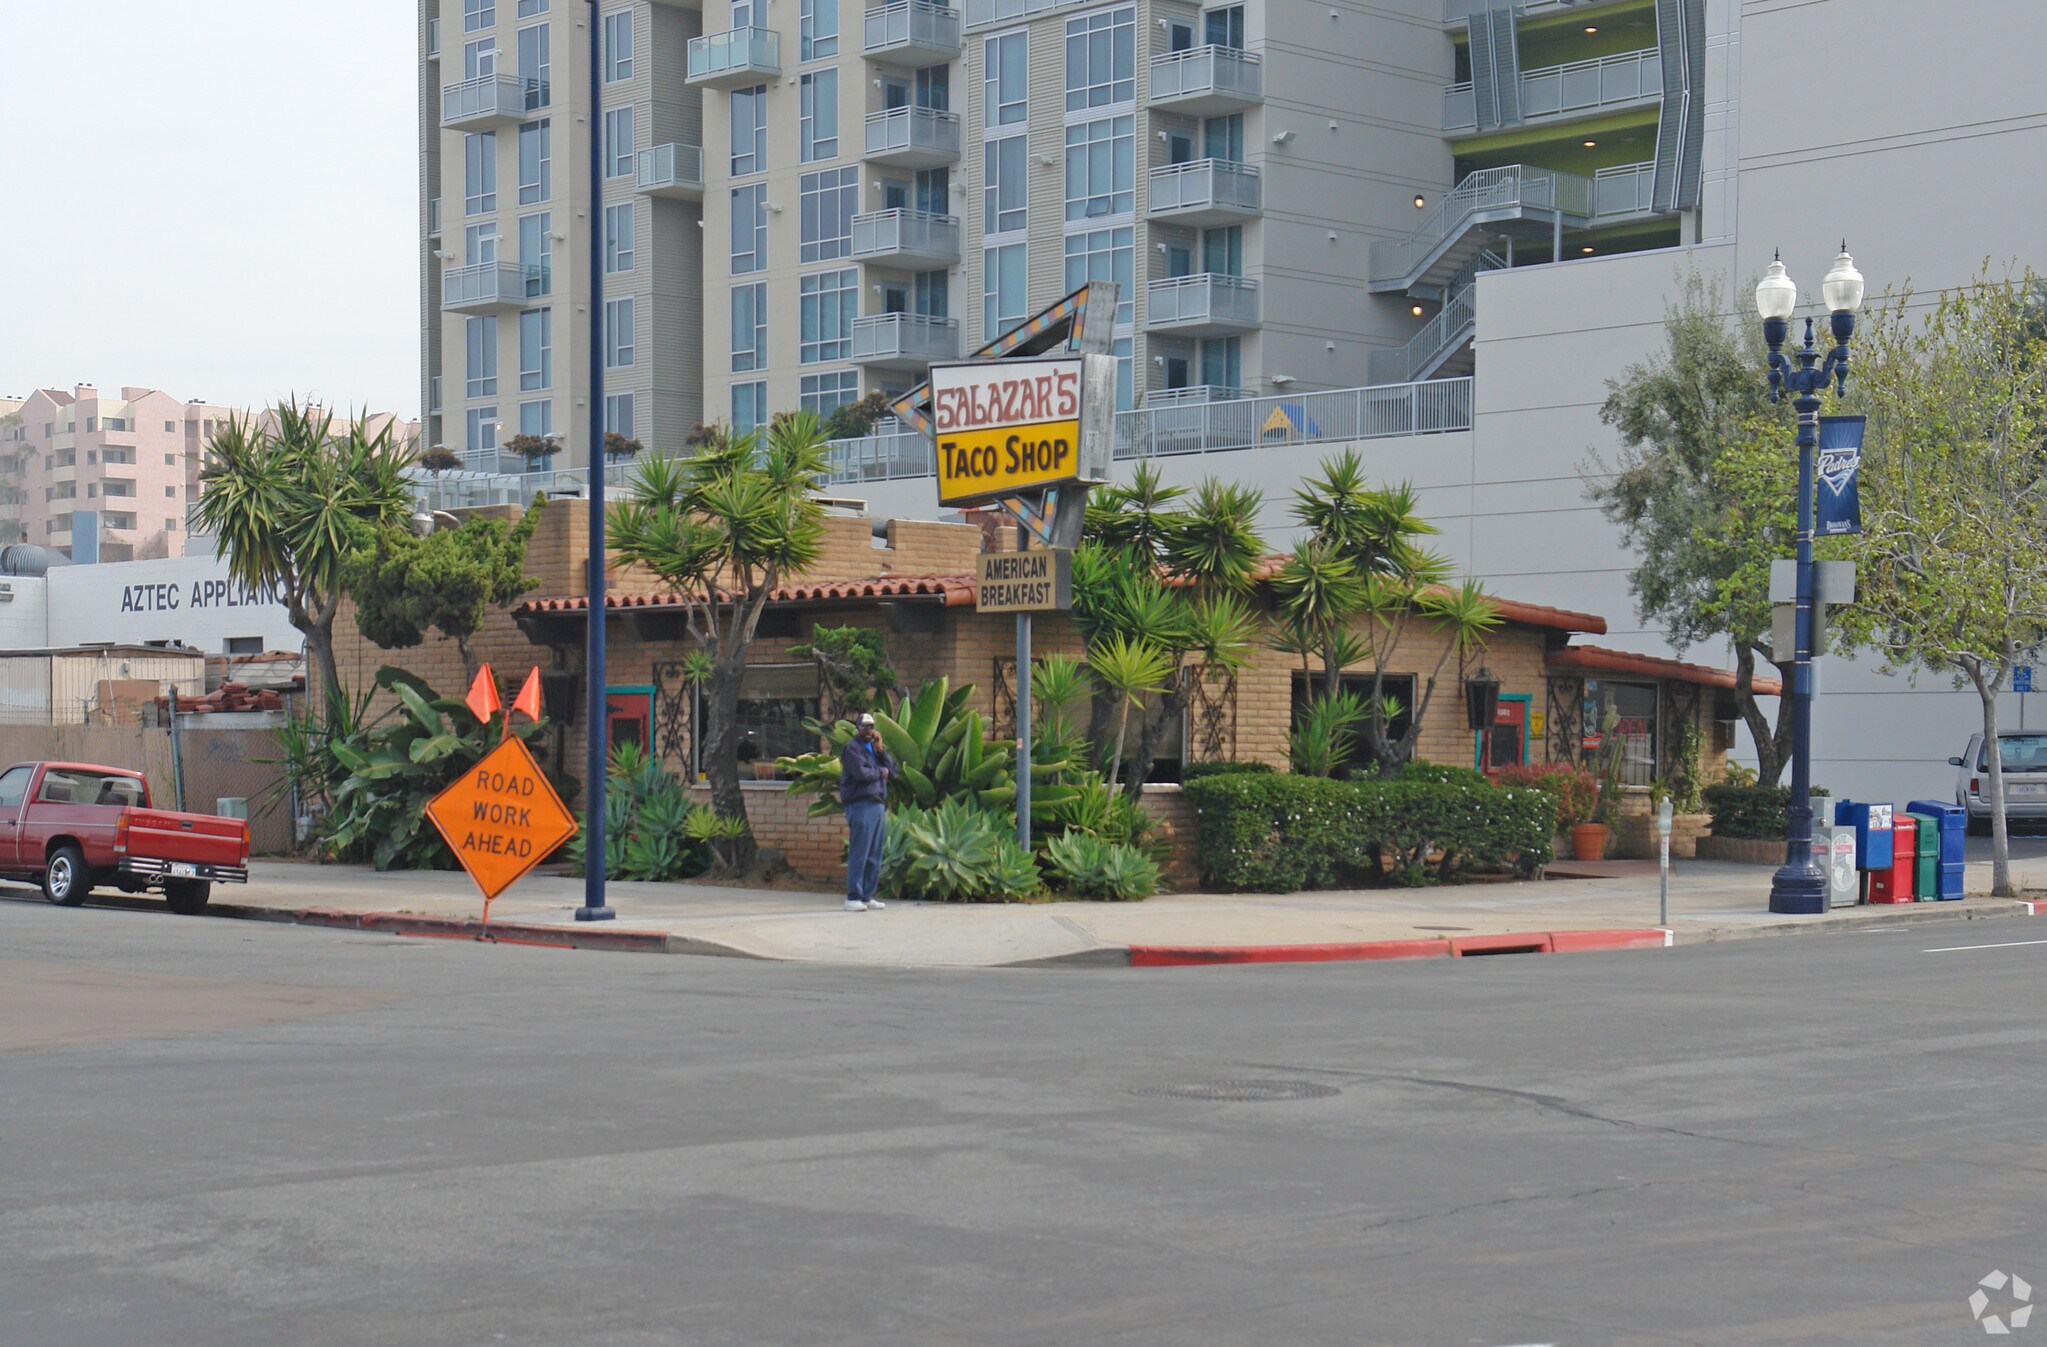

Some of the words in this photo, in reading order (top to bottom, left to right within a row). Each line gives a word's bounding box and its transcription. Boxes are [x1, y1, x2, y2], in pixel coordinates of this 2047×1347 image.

[937, 368, 1078, 429] SALAZAR'S
[941, 442, 998, 480] TACO
[1005, 435, 1069, 474] SHOP
[1818, 454, 1860, 477] Padres
[985, 556, 1047, 580] AMERICAN
[121, 583, 180, 612] AZTEC
[981, 582, 1051, 606] BREAKFAST
[477, 770, 534, 796] ROAD
[473, 801, 532, 827] WORK
[462, 832, 532, 857] AHEAD
